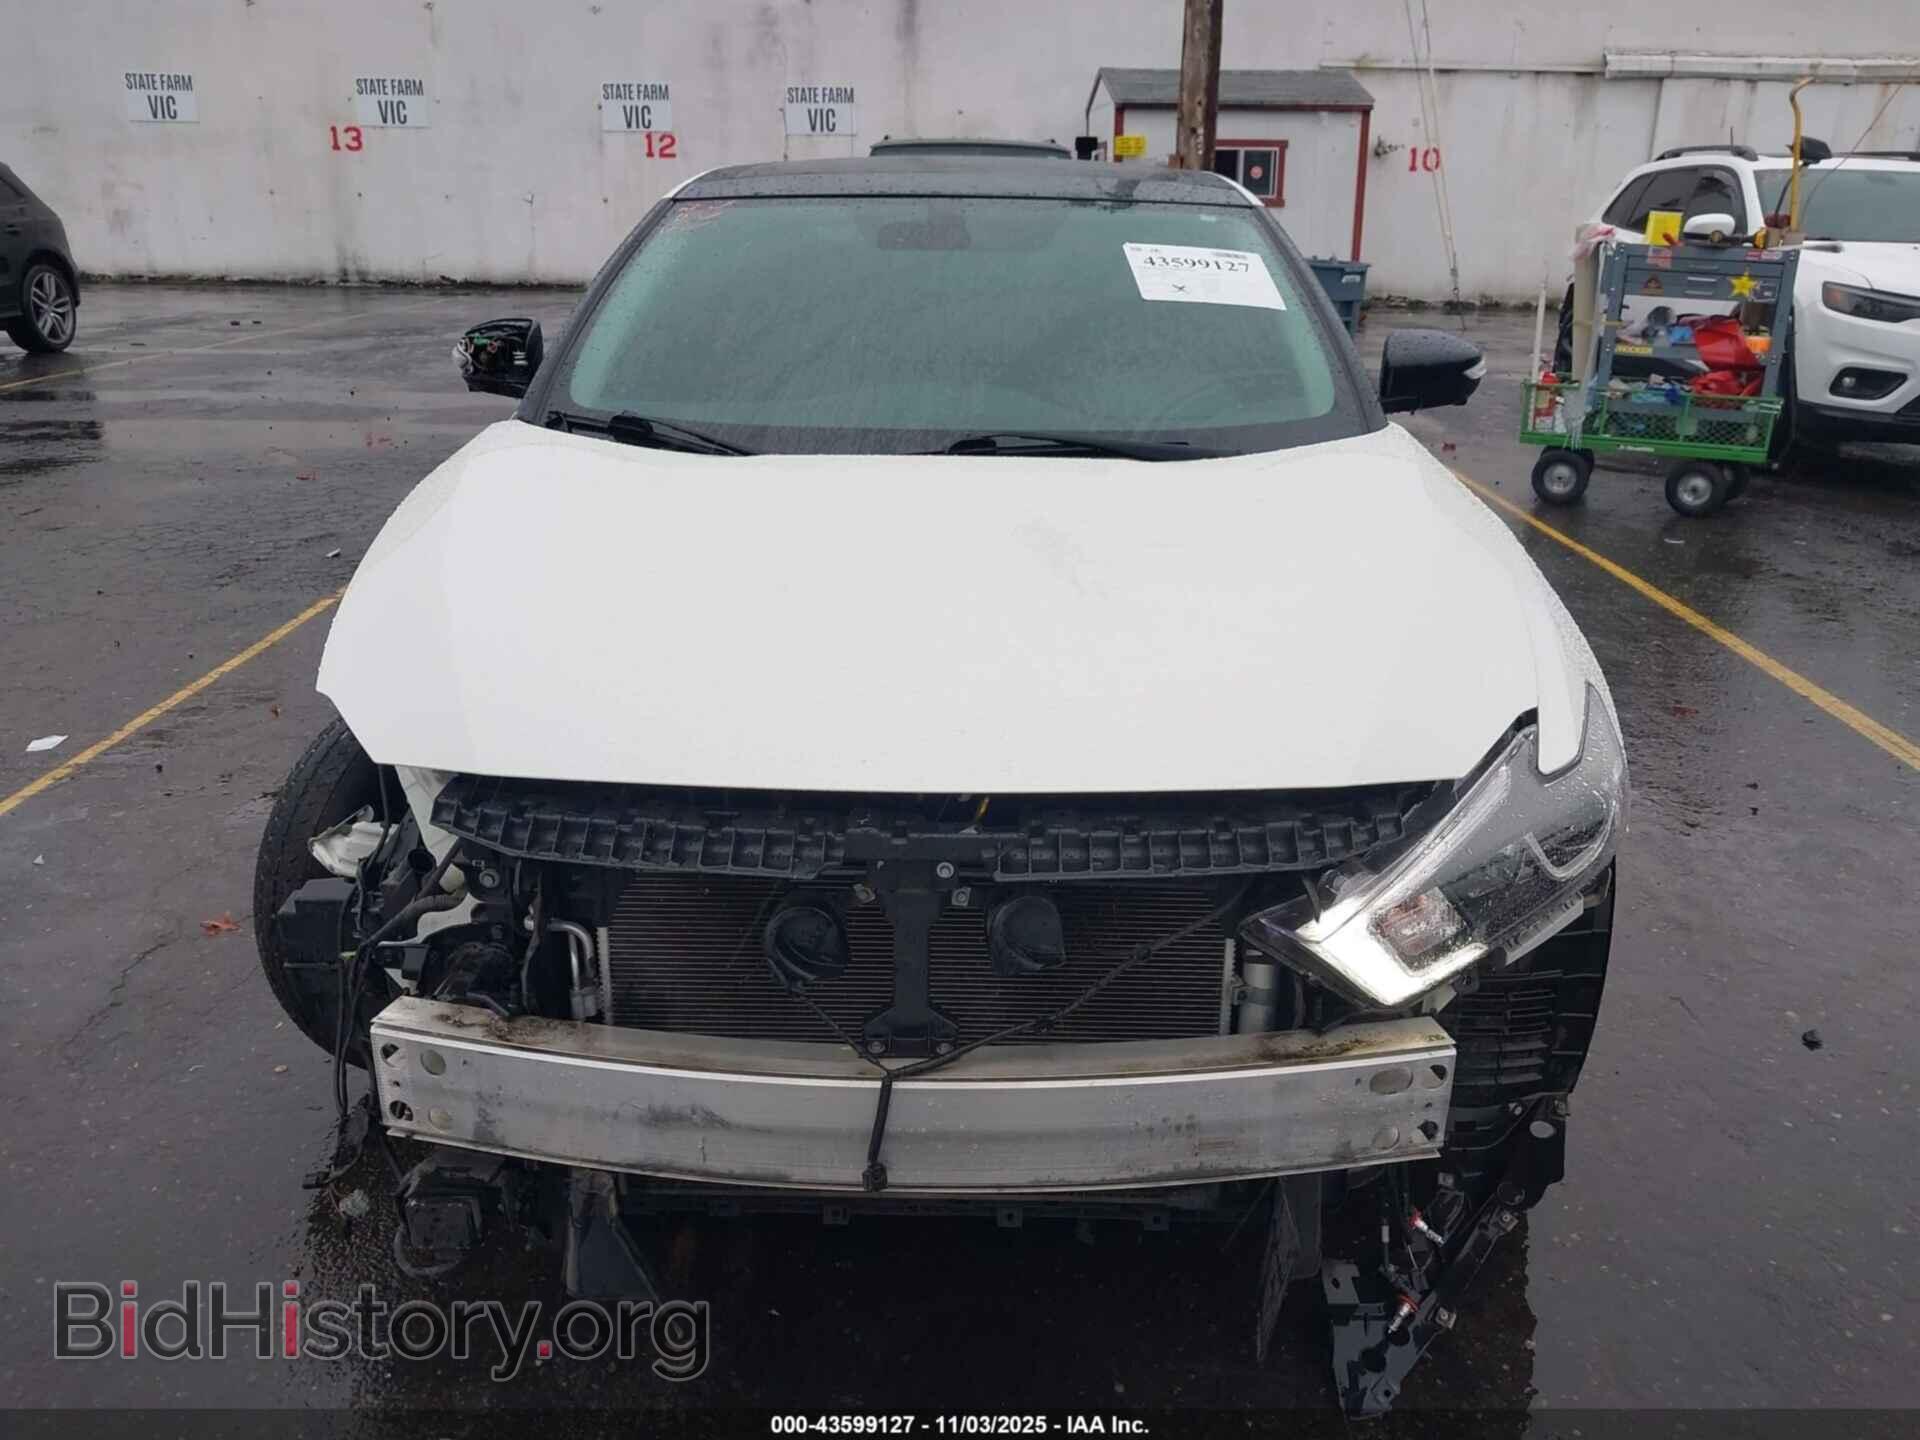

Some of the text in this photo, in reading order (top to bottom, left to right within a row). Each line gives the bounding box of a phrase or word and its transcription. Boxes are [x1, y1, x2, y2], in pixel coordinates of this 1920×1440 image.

[125, 73, 193, 91] STATE FARM
[356, 78, 424, 96] STATE FARM
[602, 83, 670, 101] STATE FARM
[787, 87, 855, 104] STATE FARM
[147, 95, 177, 120] VIC
[378, 101, 407, 124] VIC
[623, 105, 652, 129] VIC
[807, 108, 836, 132] VIC
[329, 125, 363, 151] 13
[645, 133, 677, 158] 12
[1408, 147, 1441, 172] 10
[1143, 256, 1249, 273] 43599127
